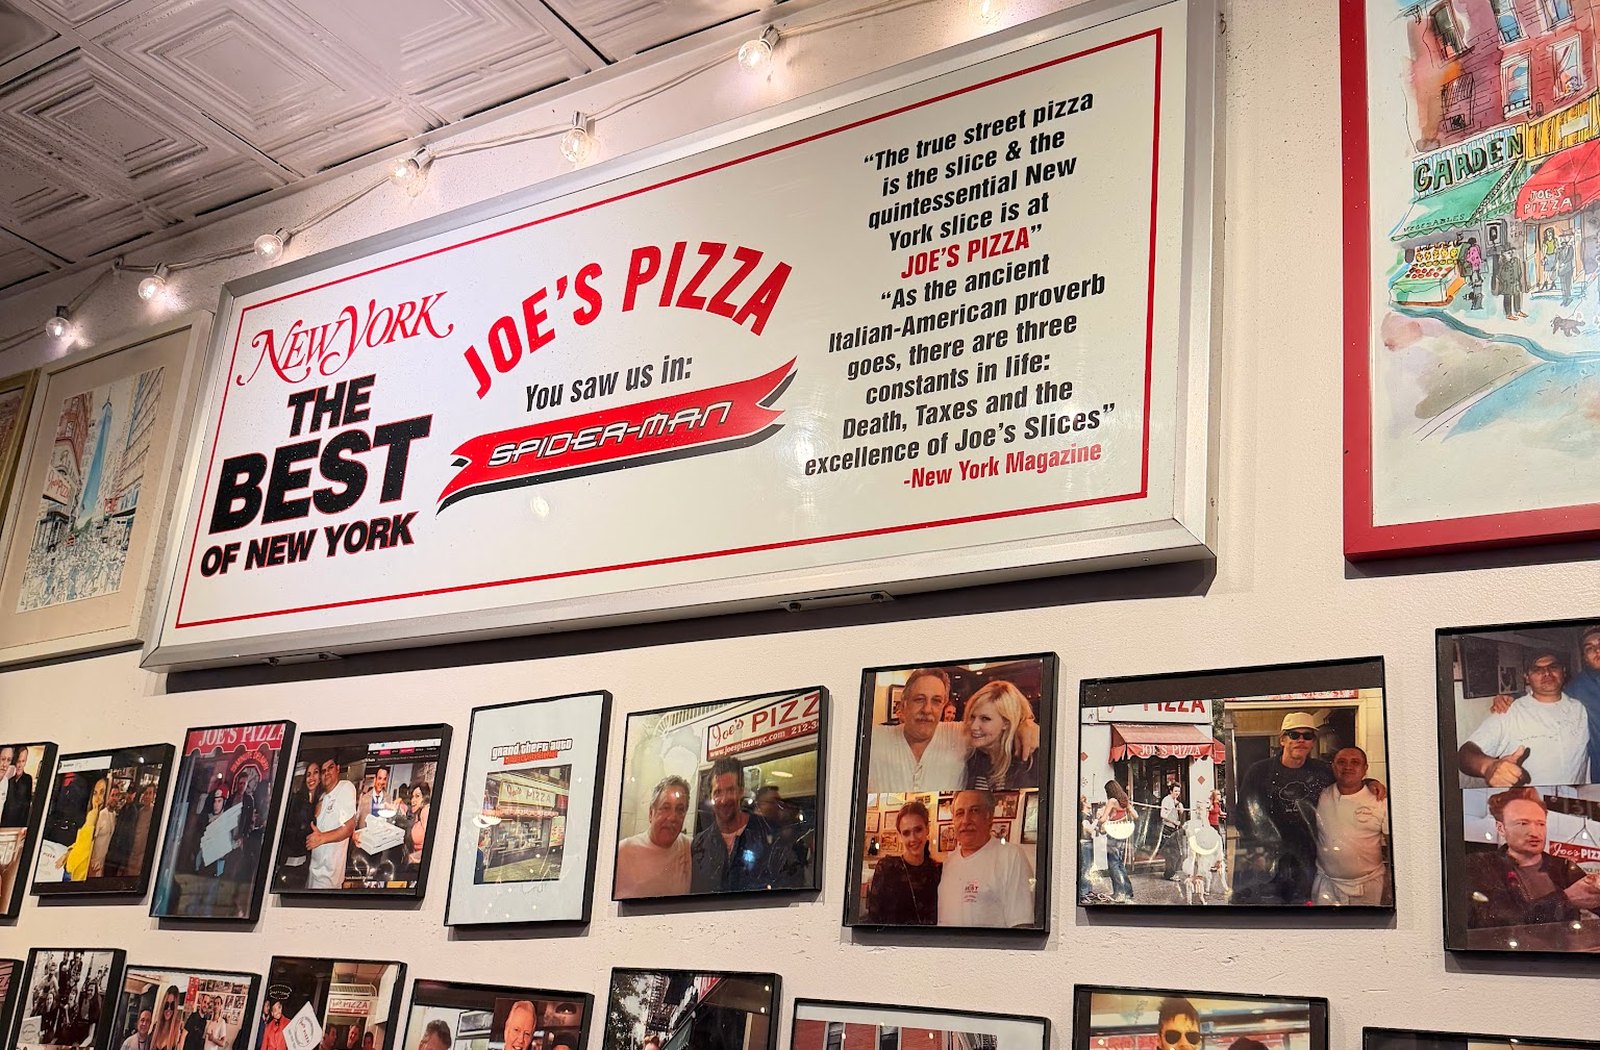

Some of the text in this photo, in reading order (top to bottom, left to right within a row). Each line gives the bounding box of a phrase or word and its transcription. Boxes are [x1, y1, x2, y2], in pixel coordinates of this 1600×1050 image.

[863, 93, 1094, 173] “The true street pizza
[882, 131, 1066, 197] is the slice & the
[1414, 133, 1523, 193] GARDEN
[868, 157, 1078, 230] quintessential New
[889, 193, 1049, 252] York slice is at
[1523, 197, 1573, 215] PIZZA
[901, 223, 1043, 278] JOE’S PIZZA”
[622, 241, 793, 336] PIZZA
[829, 273, 1106, 353] Italian-American proverb
[881, 254, 1050, 310] “As the ancient
[848, 313, 1078, 381] goes, there are three
[287, 373, 376, 436] THE
[526, 354, 694, 413] You saw us in:
[843, 379, 1073, 440] Death, Taxes and the
[866, 352, 1050, 405] constants in life:
[488, 399, 733, 468] SPIDER-MAN
[804, 403, 1115, 477] excellence of Joe’s Slices”
[208, 414, 433, 535] BEST
[903, 444, 1101, 489] -New York Magazine
[200, 511, 423, 577] OF NEW YORK
[491, 743, 520, 761] grand
[549, 738, 573, 752] auto
[1171, 743, 1201, 756] PIZZA
